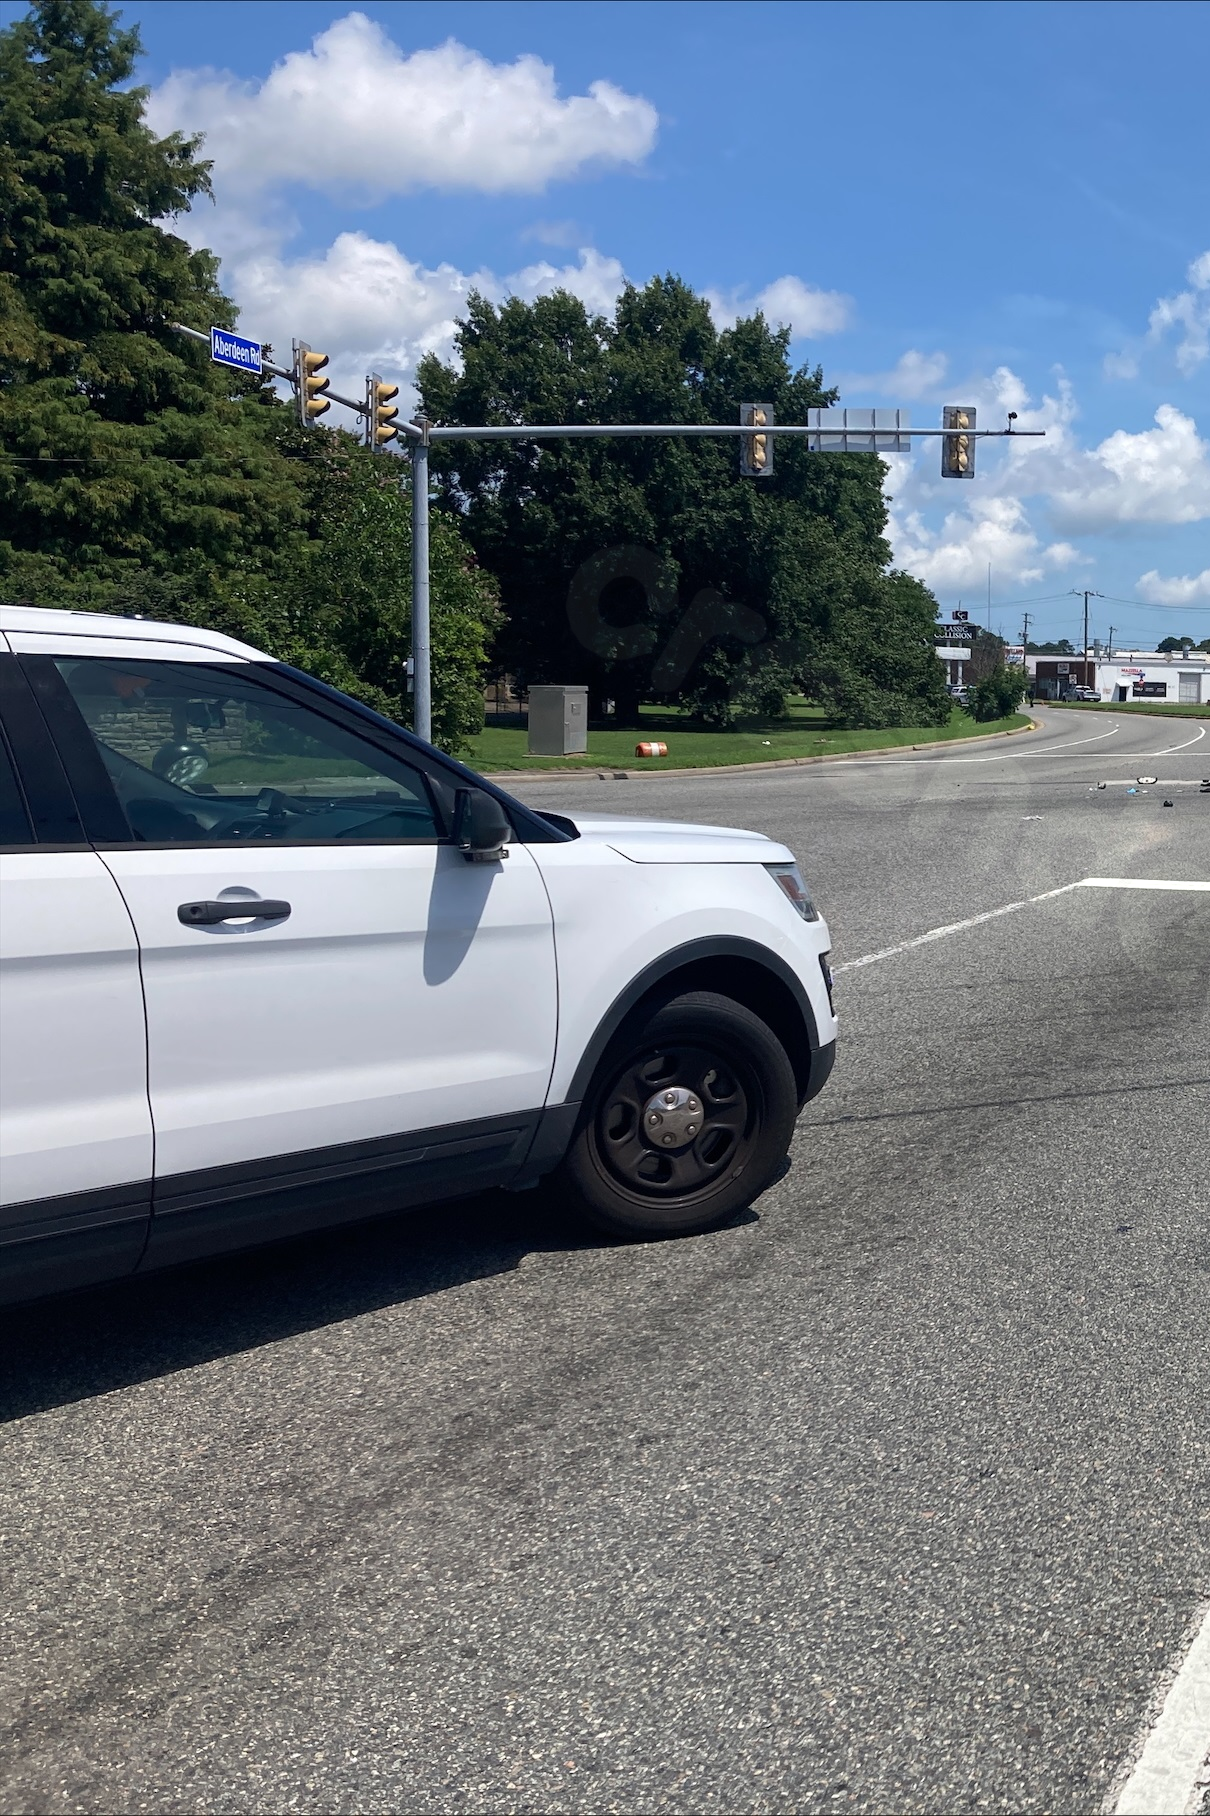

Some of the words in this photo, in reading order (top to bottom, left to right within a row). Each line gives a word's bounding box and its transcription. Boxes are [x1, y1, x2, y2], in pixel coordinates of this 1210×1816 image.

[214, 335, 250, 363] Aberdeen
[250, 346, 260, 366] Rd
[940, 625, 969, 633] LASSIC
